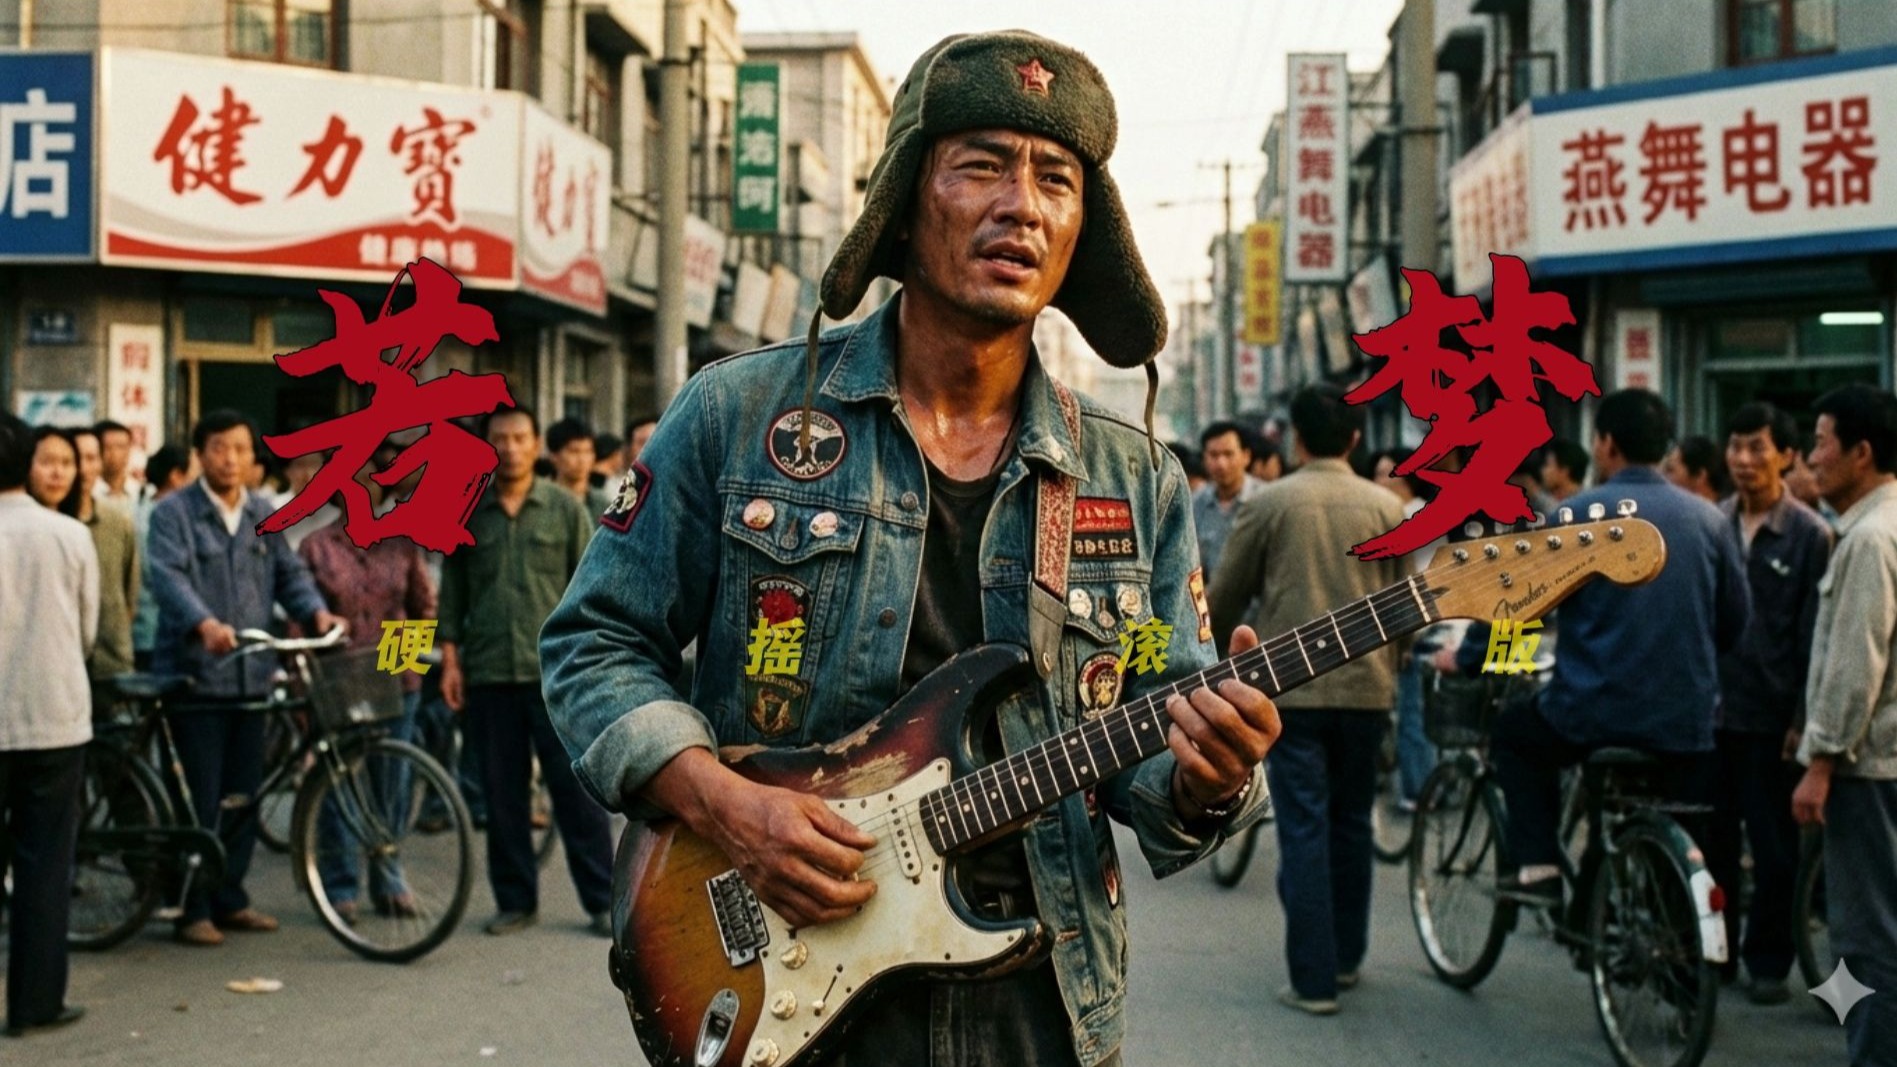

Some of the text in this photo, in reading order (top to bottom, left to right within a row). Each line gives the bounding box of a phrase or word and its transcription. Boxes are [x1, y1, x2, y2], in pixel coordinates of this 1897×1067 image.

[0, 88, 76, 219] 店
[153, 86, 477, 227] 健力寶
[1297, 63, 1335, 270] 江燕舞电器
[1561, 96, 1878, 233] 燕舞电器
